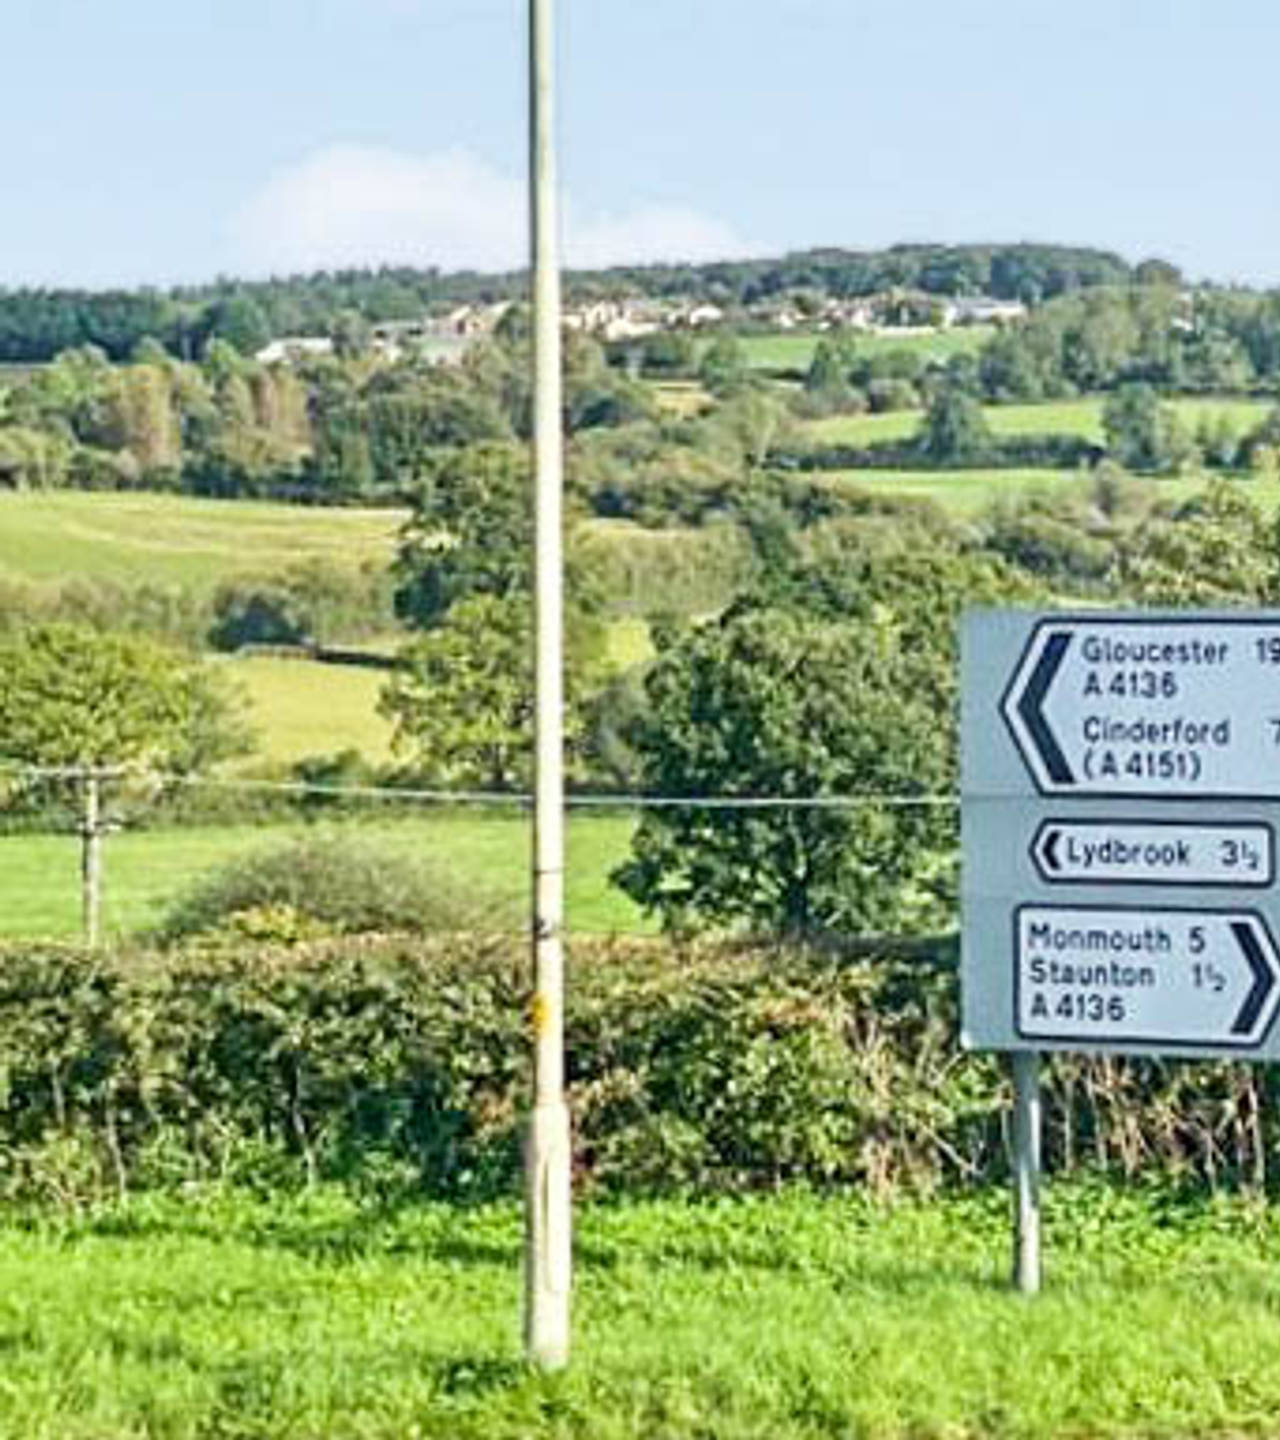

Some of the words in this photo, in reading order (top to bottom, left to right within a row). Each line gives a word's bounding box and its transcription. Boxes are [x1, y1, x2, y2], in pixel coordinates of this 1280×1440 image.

[1081, 636, 1228, 664] Gloucester
[1083, 716, 1230, 744] Cinderford
[1067, 837, 1190, 868] Lydbrook
[1028, 923, 1171, 951] Monmouth
[1188, 926, 1206, 953] 5
[1029, 958, 1155, 987] Staunton
